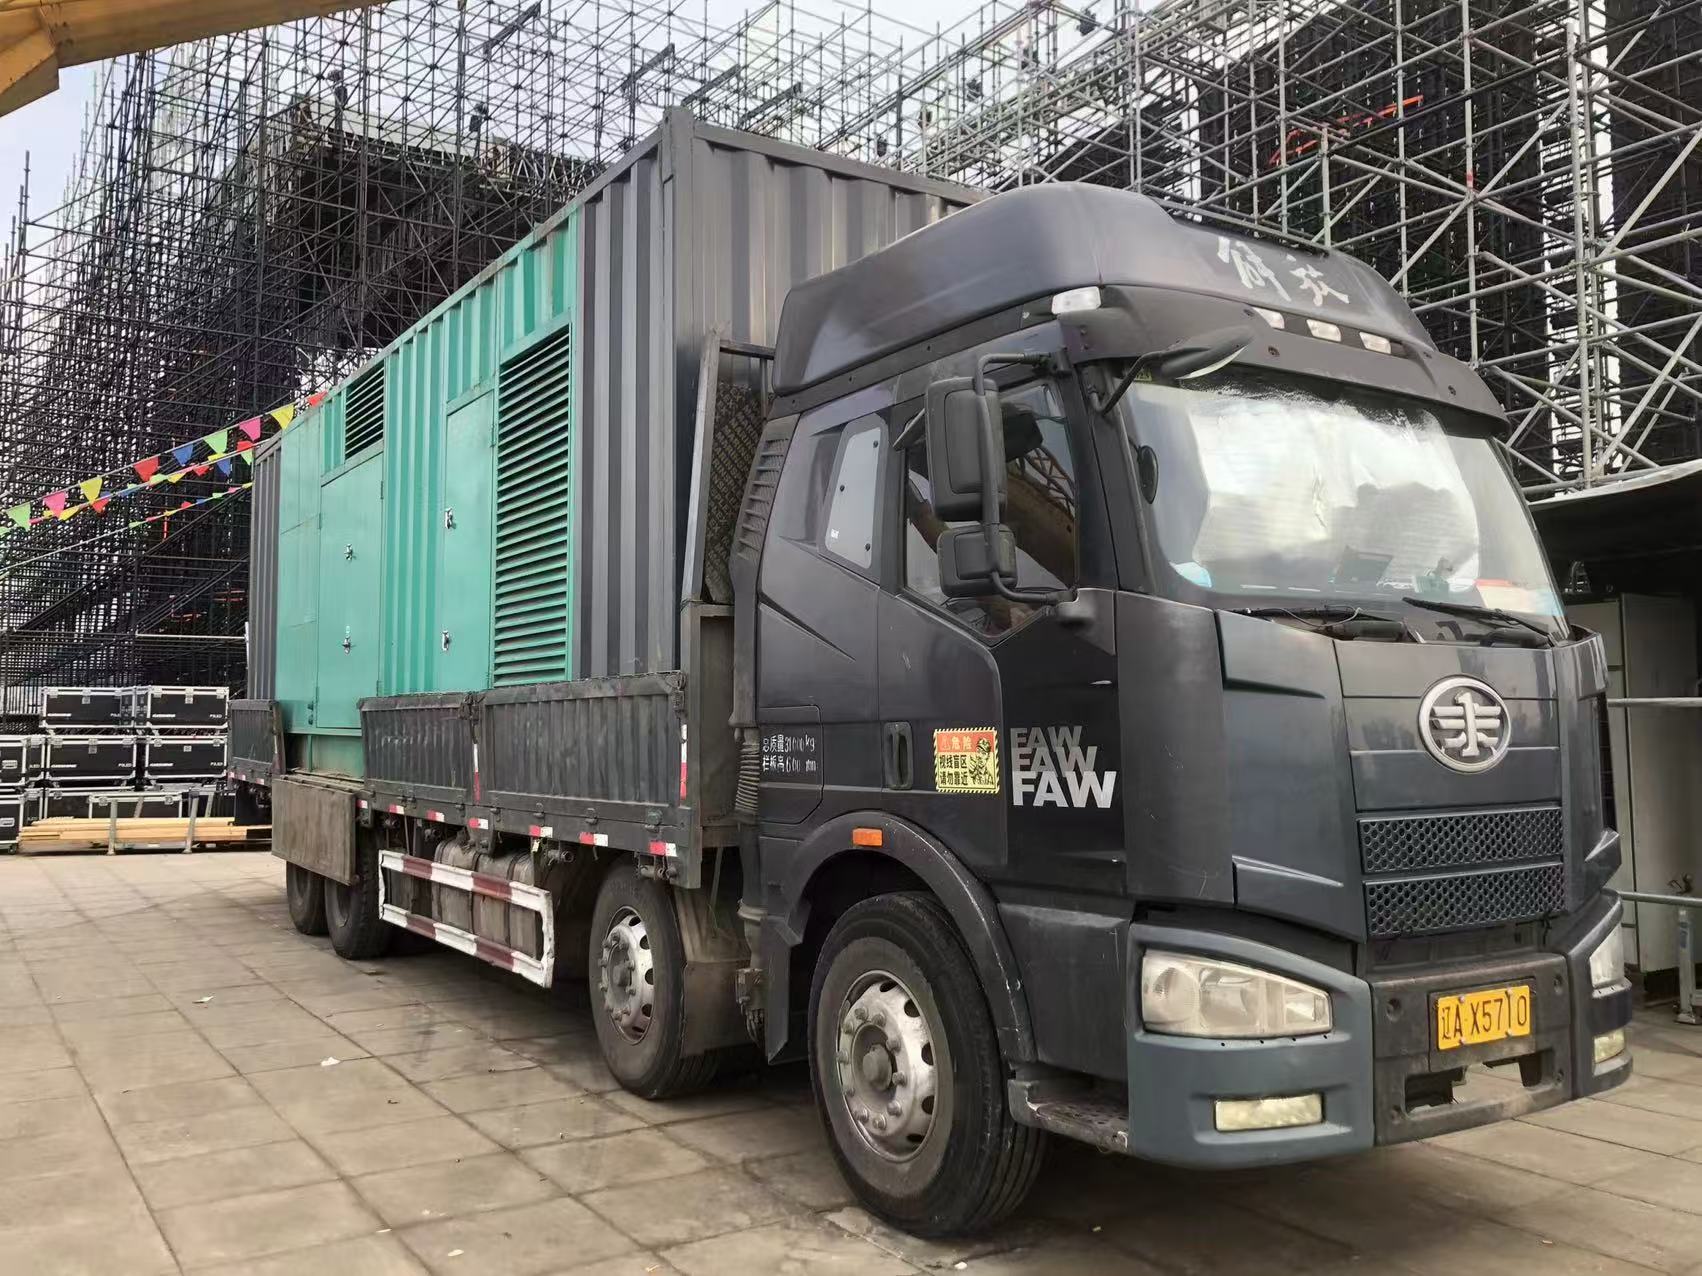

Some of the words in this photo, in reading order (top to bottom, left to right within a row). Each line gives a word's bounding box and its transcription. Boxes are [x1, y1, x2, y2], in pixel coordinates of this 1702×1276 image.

[951, 735, 972, 750] 危险
[1010, 725, 1083, 752] FAW
[939, 754, 967, 769] 视线盲区
[1010, 745, 1098, 778] FAW
[939, 771, 969, 786] 请勿靠近
[1011, 770, 1117, 809] FAW
